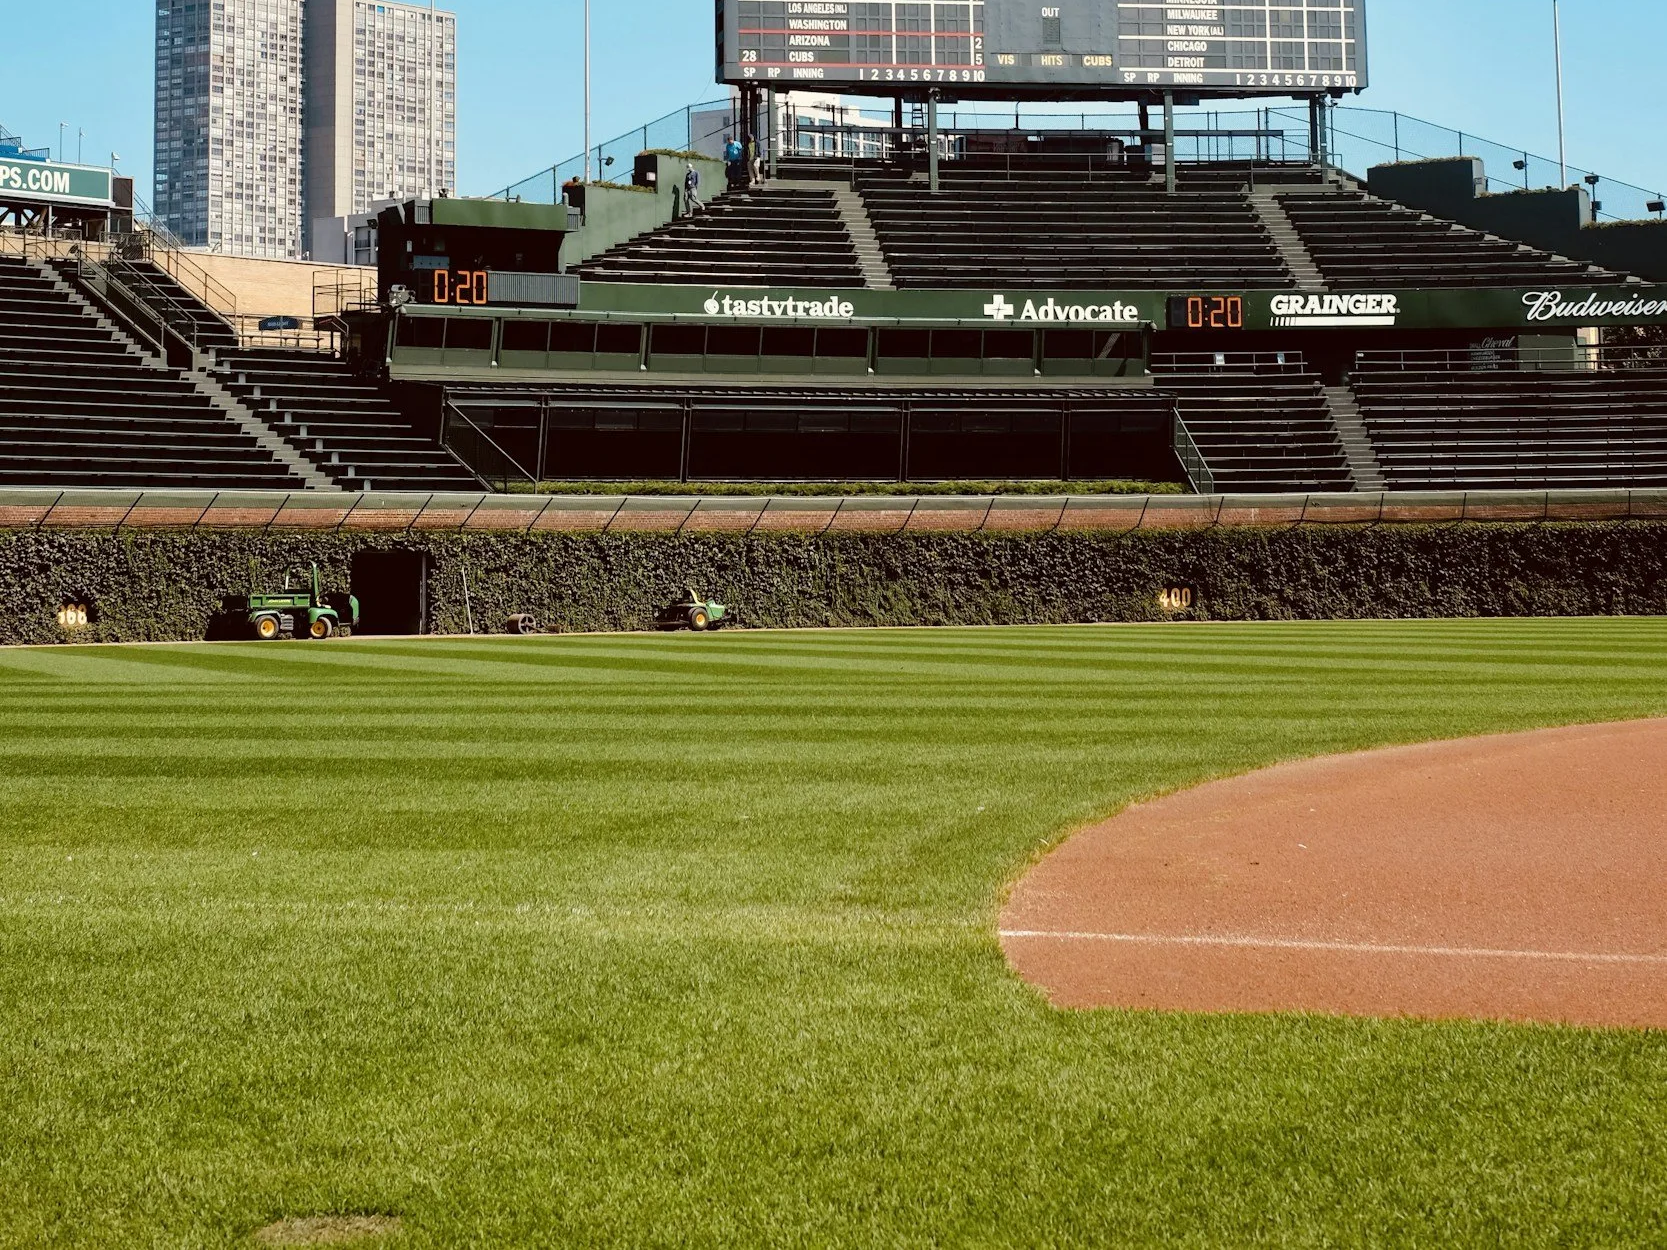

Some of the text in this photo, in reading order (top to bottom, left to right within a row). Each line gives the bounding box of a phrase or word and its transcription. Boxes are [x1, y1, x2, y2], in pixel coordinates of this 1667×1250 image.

[788, 3, 802, 13] LOS
[1042, 8, 1060, 17] OUT
[1167, 9, 1218, 20] MILWAUKEE
[789, 19, 847, 31] WASHINGTON
[1167, 25, 1187, 35] NEW
[789, 35, 982, 49] ARIZONA 2
[1167, 41, 1207, 52] CHICAGO
[742, 51, 983, 65] 28 CUBS 5
[998, 55, 1112, 66] VIS HITS CUBS
[1168, 56, 1204, 68] DETROIT
[743, 67, 985, 82] SP RP INNING 1 2 3 4 5 6 7 8 9 10
[1124, 72, 1357, 87] SP RP INNING 1 2 3 4 5 6 7 8 9 10
[434, 269, 487, 304] 0:20
[721, 294, 854, 318] tastytrade
[1020, 297, 1138, 321] Advocate
[1270, 294, 1397, 315] GRAINGER
[1521, 290, 1667, 321] Budweiser
[1187, 296, 1242, 328] 0:20
[1160, 587, 1191, 607] 400
